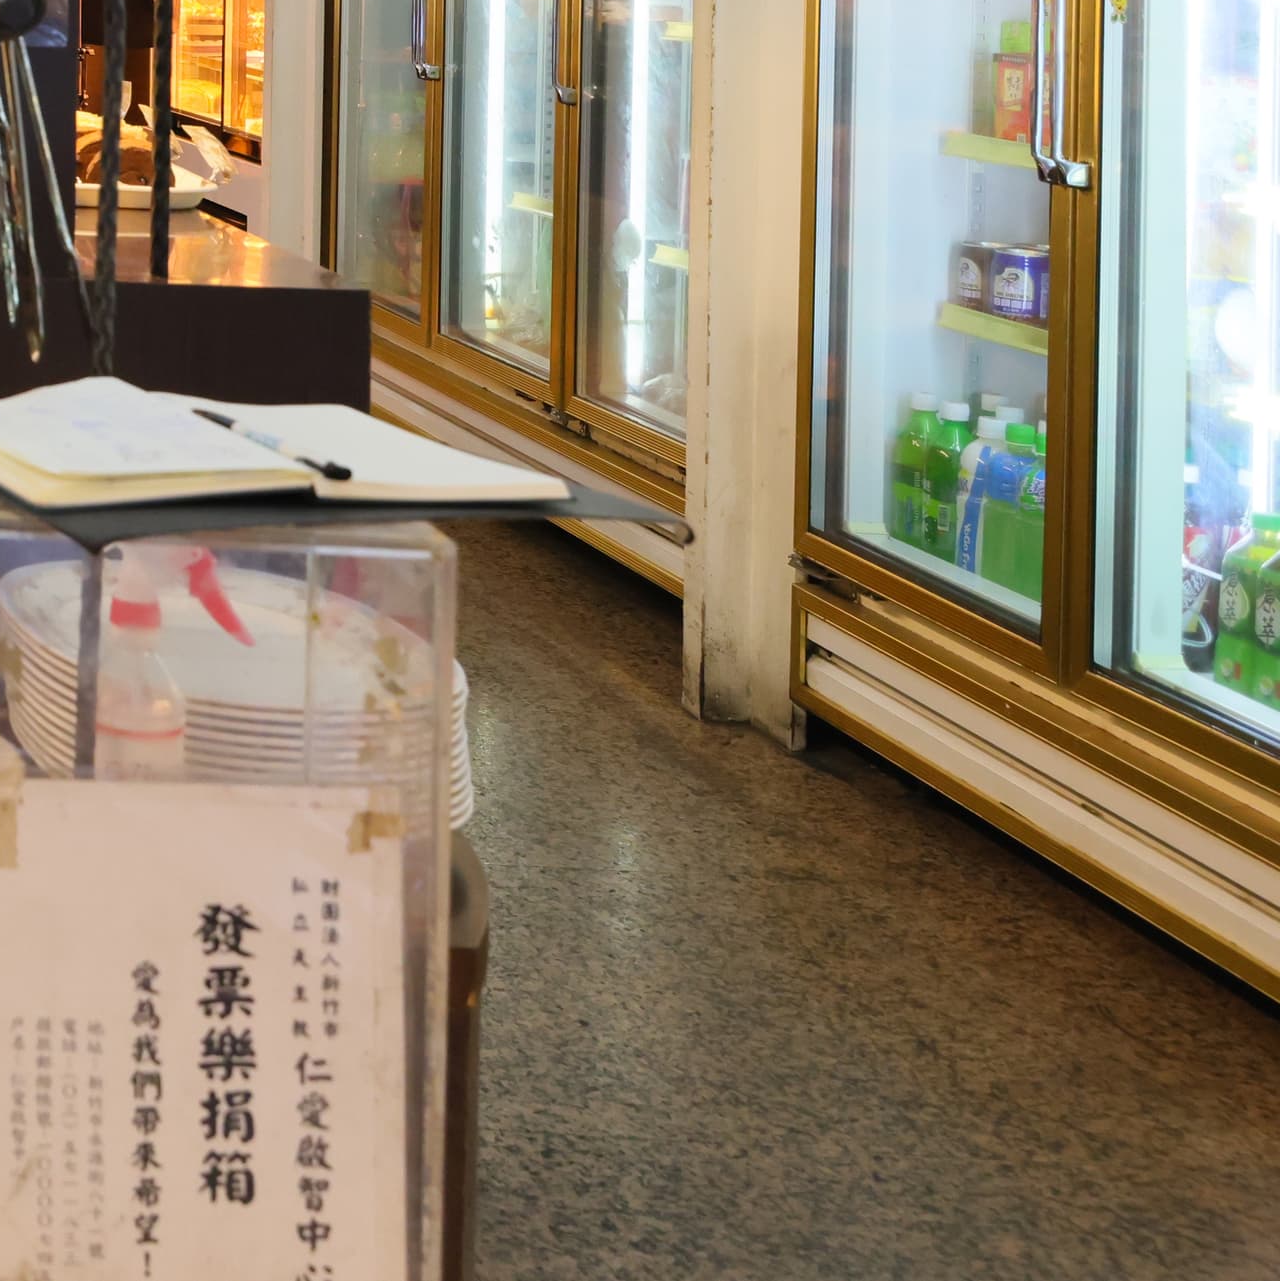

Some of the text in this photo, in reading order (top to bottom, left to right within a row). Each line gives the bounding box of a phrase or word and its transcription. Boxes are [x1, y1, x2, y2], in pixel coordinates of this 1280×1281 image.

[194, 903, 261, 1206] 發票樂捐箱
